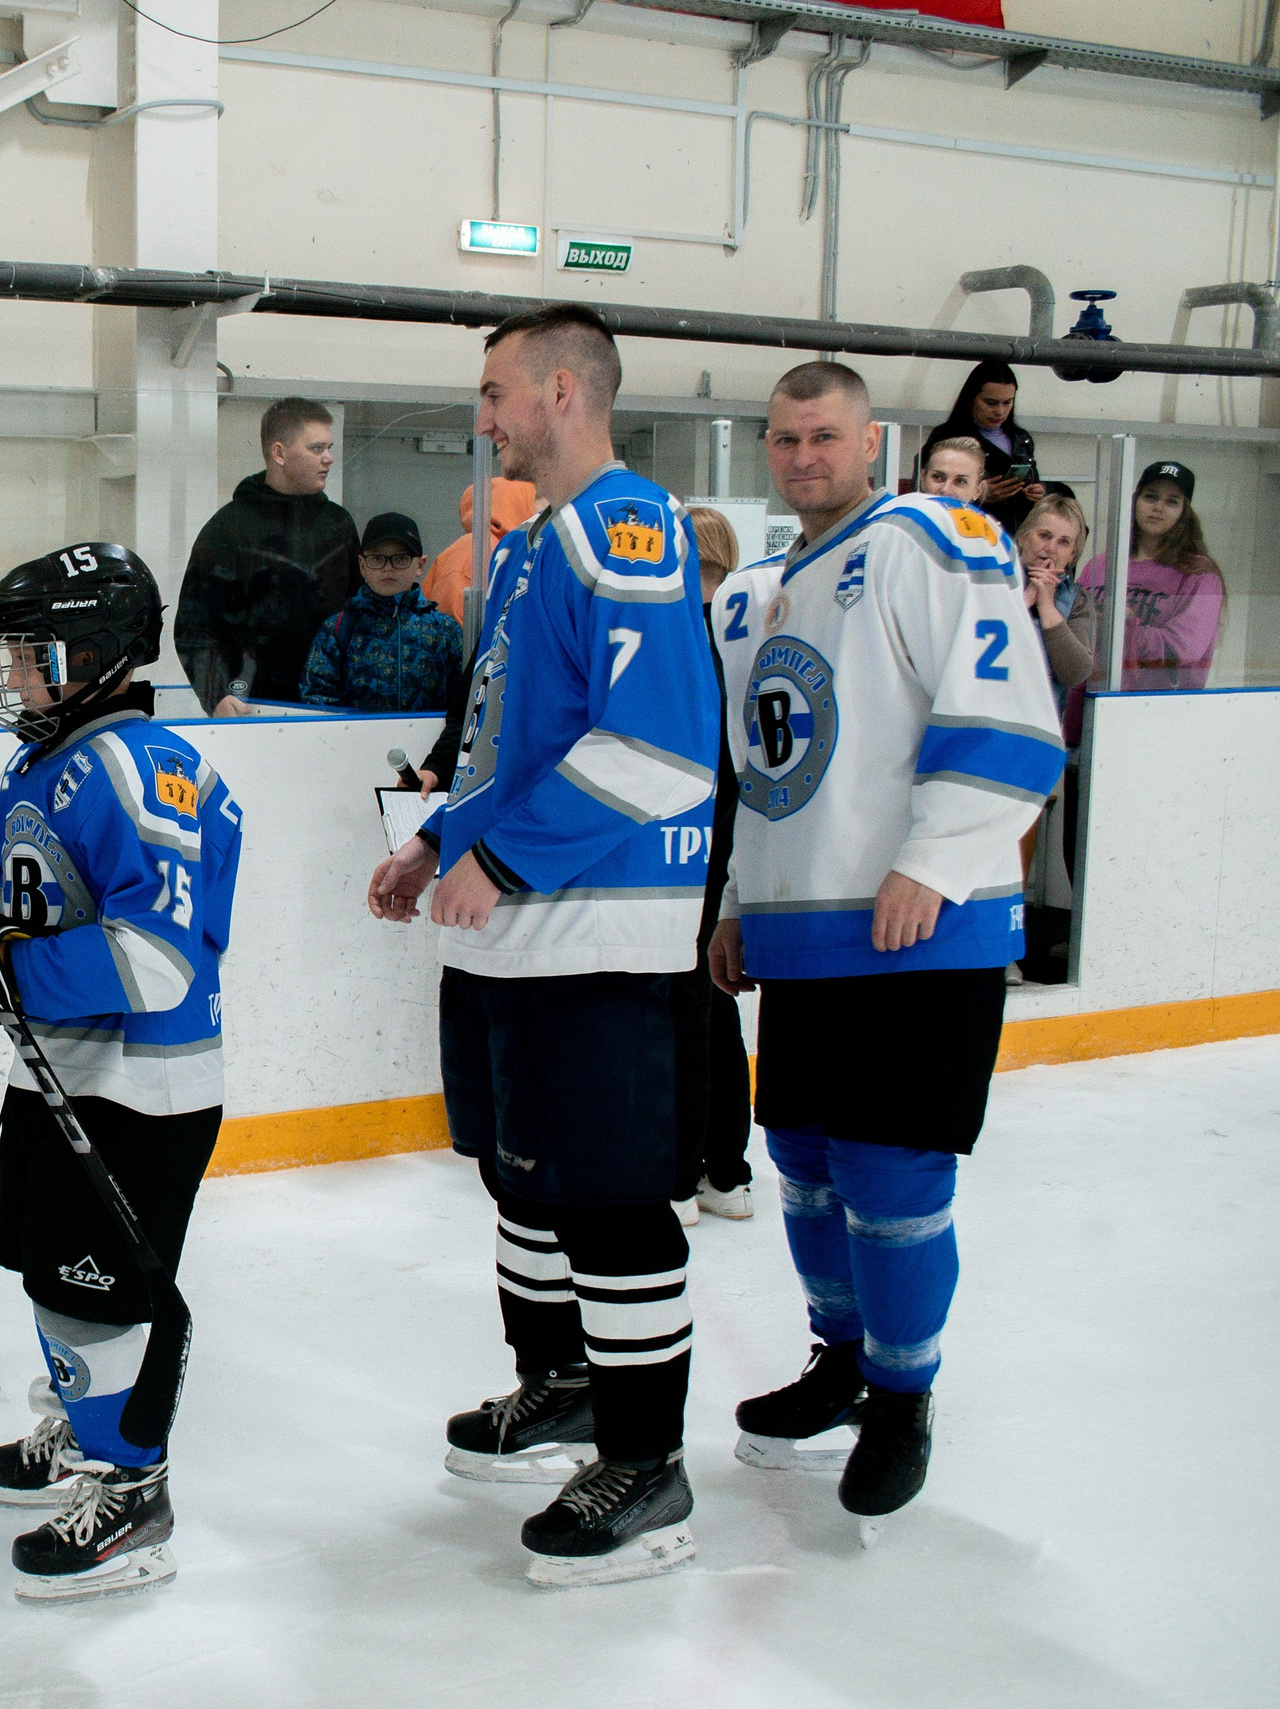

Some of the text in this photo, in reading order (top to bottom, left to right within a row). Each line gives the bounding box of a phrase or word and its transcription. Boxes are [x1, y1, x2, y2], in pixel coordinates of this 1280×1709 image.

[568, 249, 630, 268] ВЫХОД
[60, 546, 98, 578] 15
[51, 599, 98, 610] BAUER
[724, 591, 749, 642] 2
[99, 655, 129, 685] BAUER
[608, 627, 643, 689] 7
[974, 619, 1009, 682] 2
[11, 814, 63, 865] ВЫМПЕЛ
[11, 854, 48, 926] В
[151, 860, 193, 931] 15
[96, 1522, 133, 1552] BAUER
